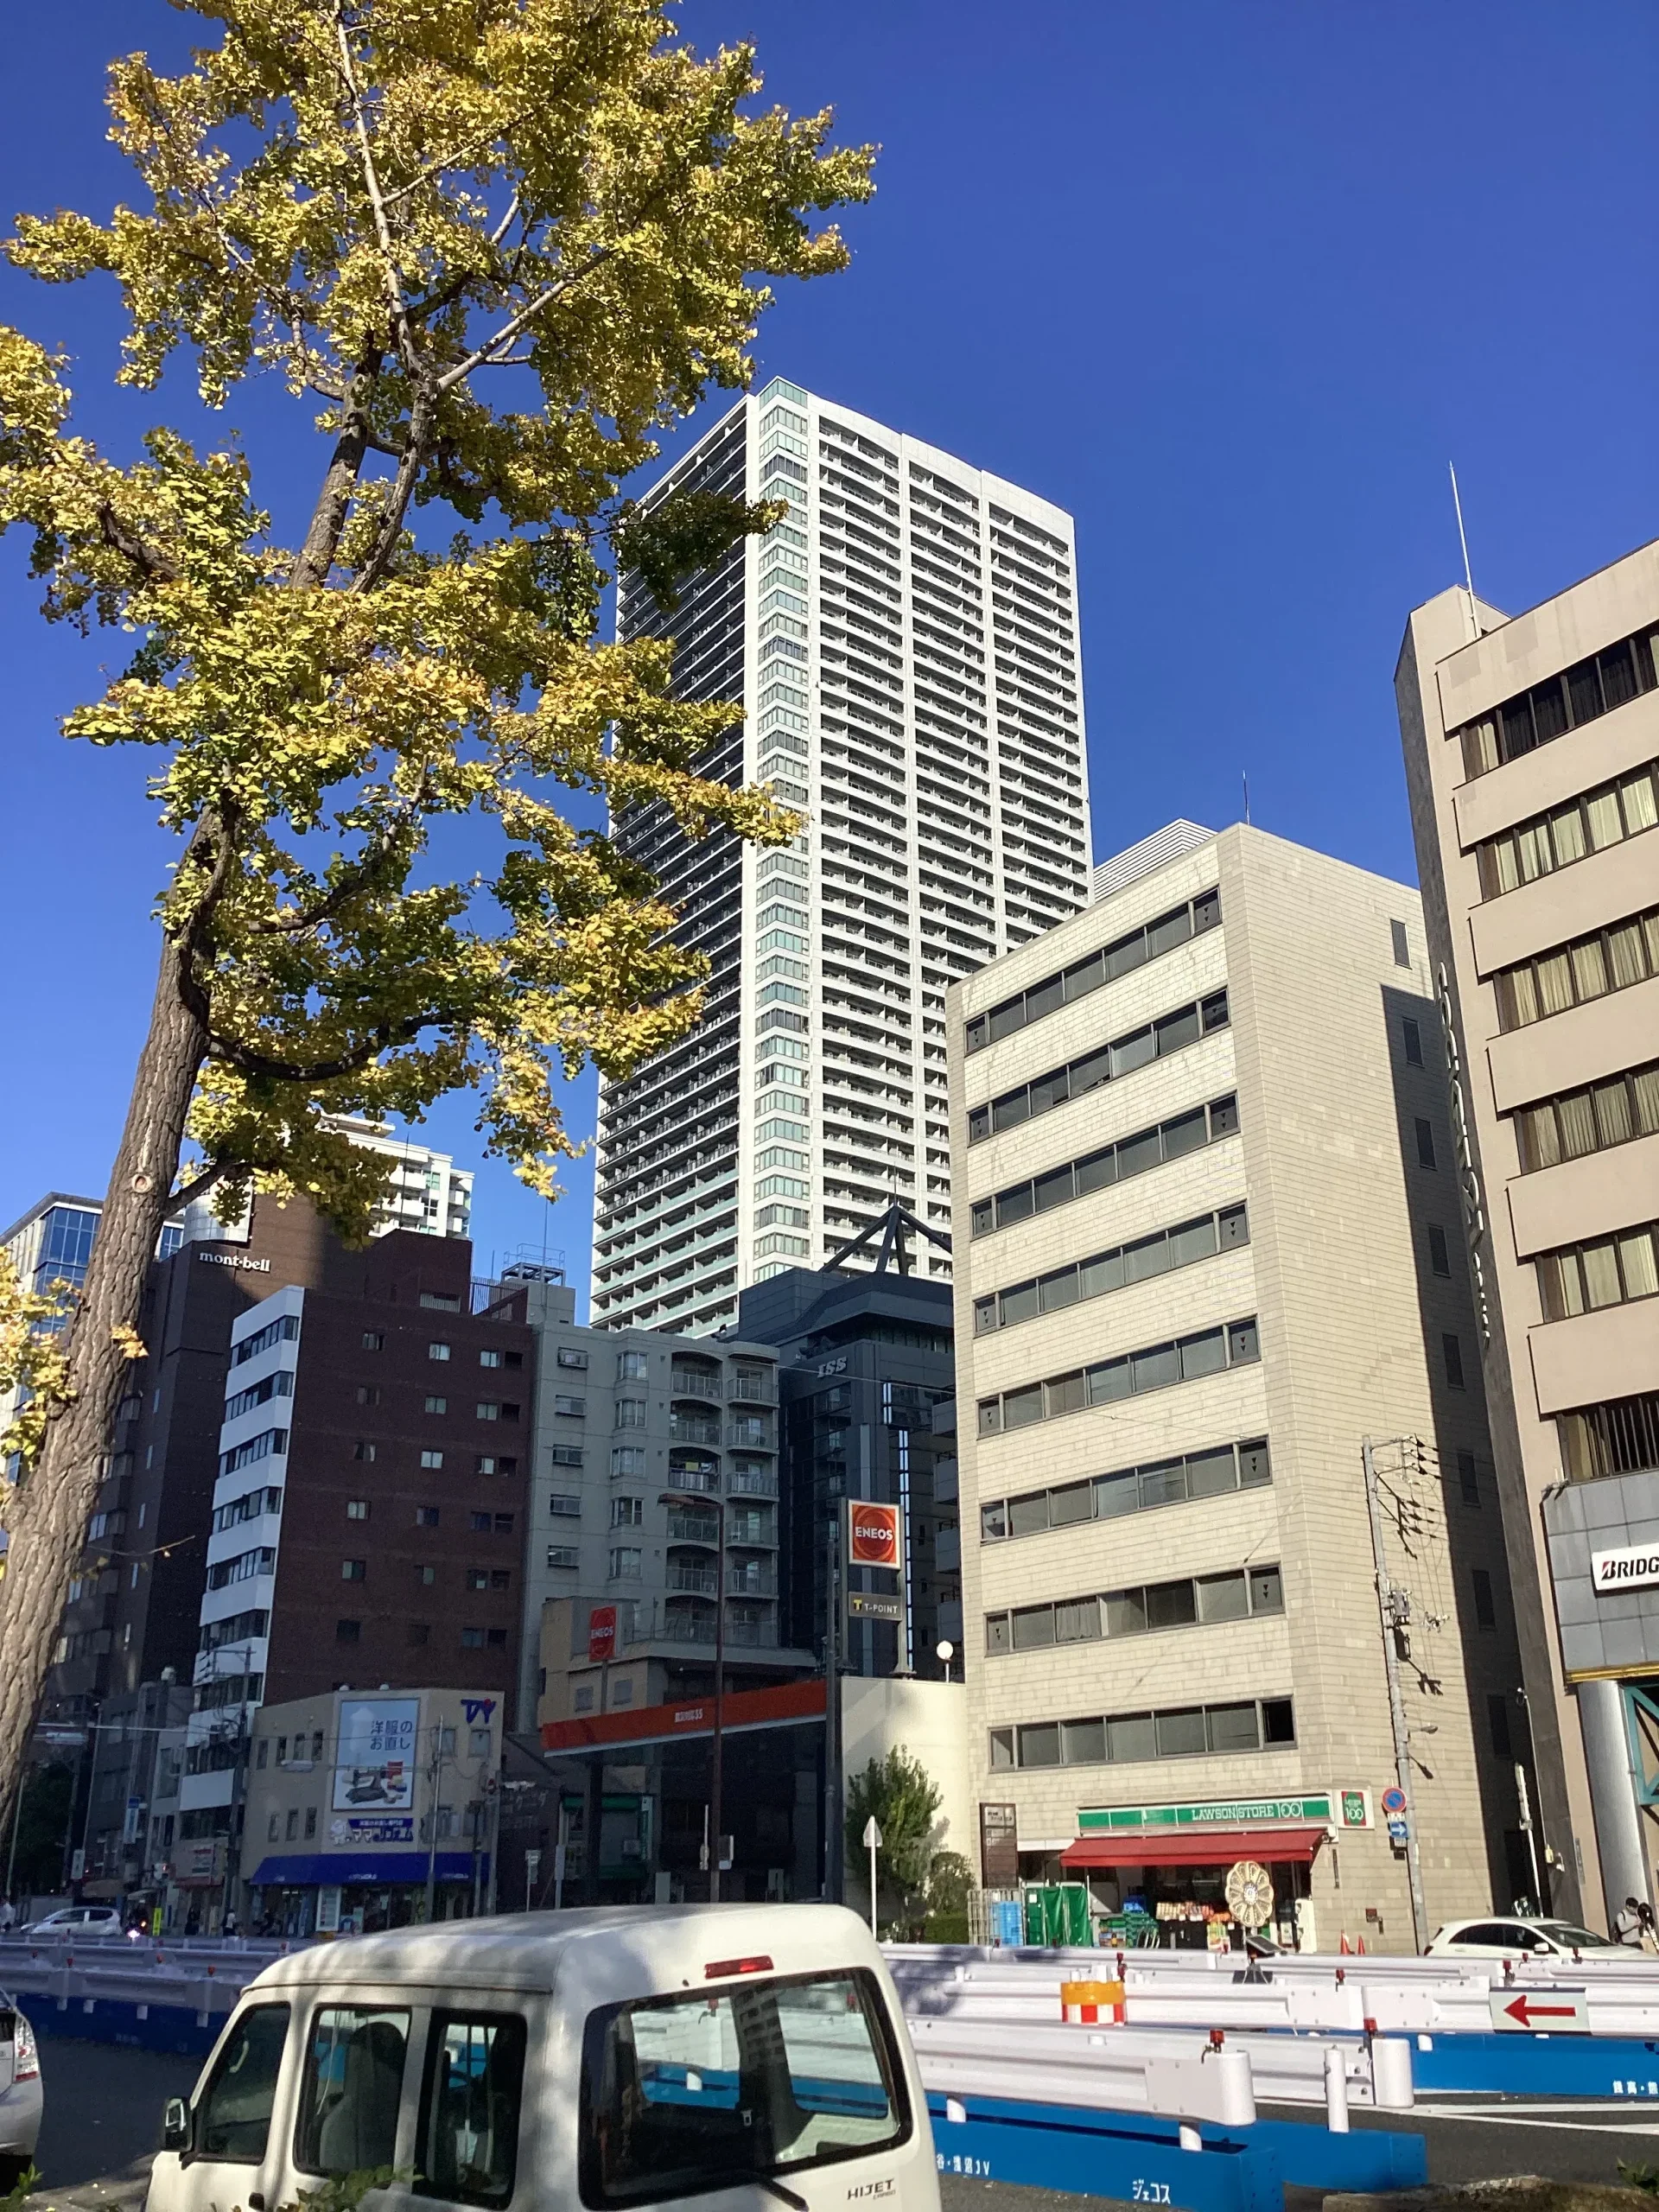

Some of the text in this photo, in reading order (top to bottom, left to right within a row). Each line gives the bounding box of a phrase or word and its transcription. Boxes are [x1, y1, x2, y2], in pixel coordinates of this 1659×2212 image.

[817, 1357, 847, 1378] ISS
[855, 1526, 893, 1541] ENEOS
[864, 1603, 898, 1614] T-POINT
[371, 1719, 413, 1735] 洋服の
[370, 1736, 411, 1751] お直し
[1192, 1802, 1301, 1821] LAWSON STORE 100
[1345, 1808, 1363, 1820] 100
[848, 2177, 894, 2200] HIJET
[1132, 2178, 1171, 2204] ジェコス
